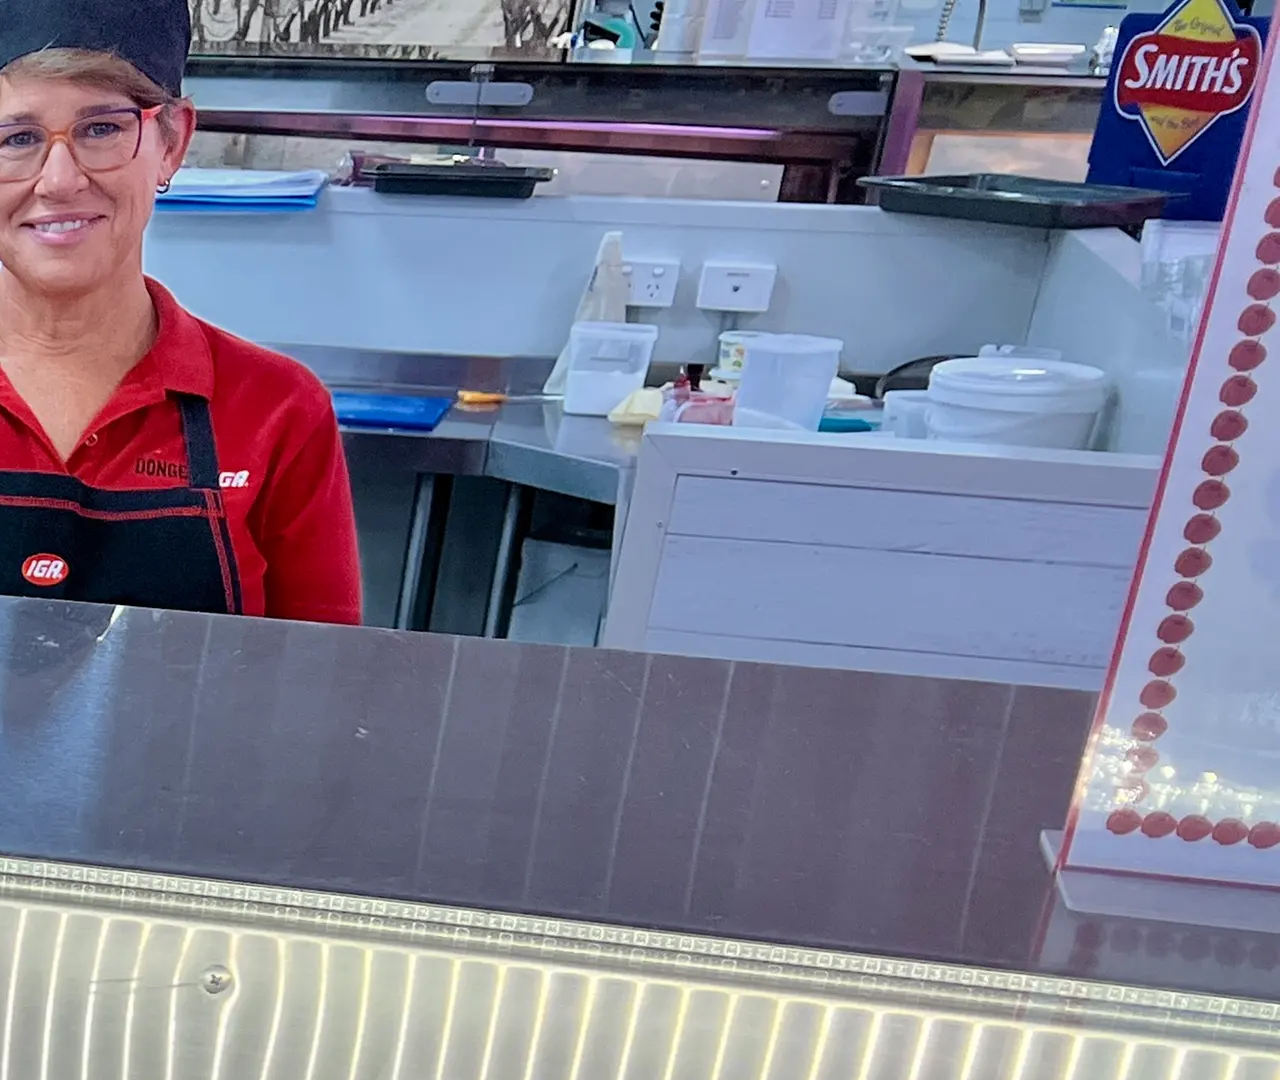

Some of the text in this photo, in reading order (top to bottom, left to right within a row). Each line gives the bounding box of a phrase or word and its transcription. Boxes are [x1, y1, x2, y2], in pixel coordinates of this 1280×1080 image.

[1125, 44, 1249, 94] SMITH'S
[135, 458, 249, 488] DONGE GA
[27, 560, 63, 578] IGA
